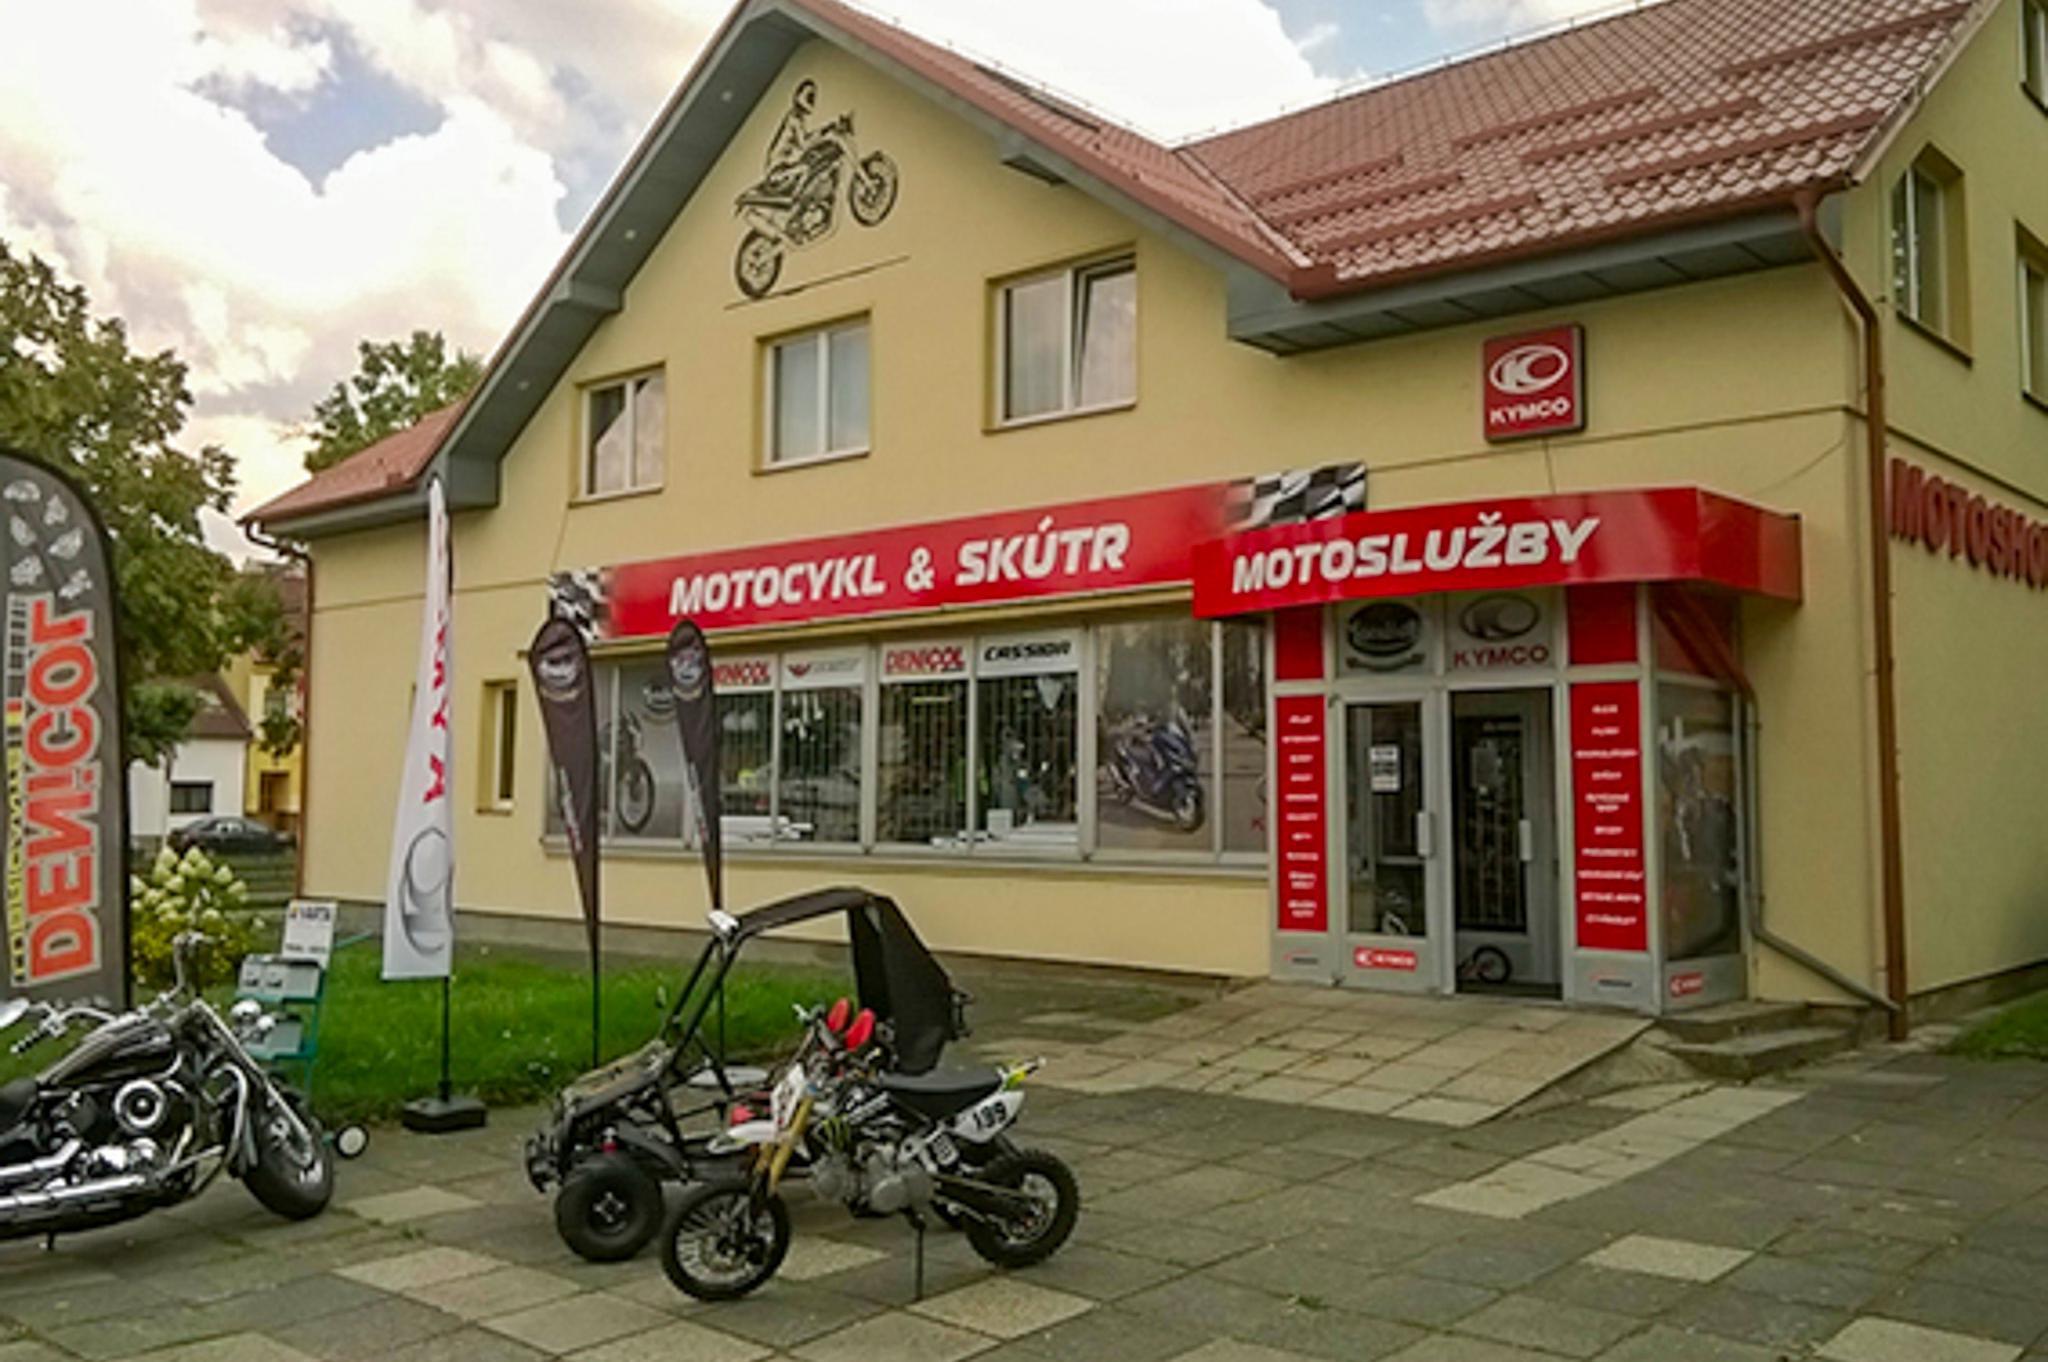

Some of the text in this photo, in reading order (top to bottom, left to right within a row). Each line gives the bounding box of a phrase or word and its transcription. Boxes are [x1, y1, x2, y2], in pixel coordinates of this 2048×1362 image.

[1489, 396, 1571, 425] KYMCO
[668, 515, 1130, 616] MOTOCYKL & SKÚTR
[1232, 511, 1601, 595] MOTOSLUŽBY
[1454, 644, 1550, 668] KYMCO
